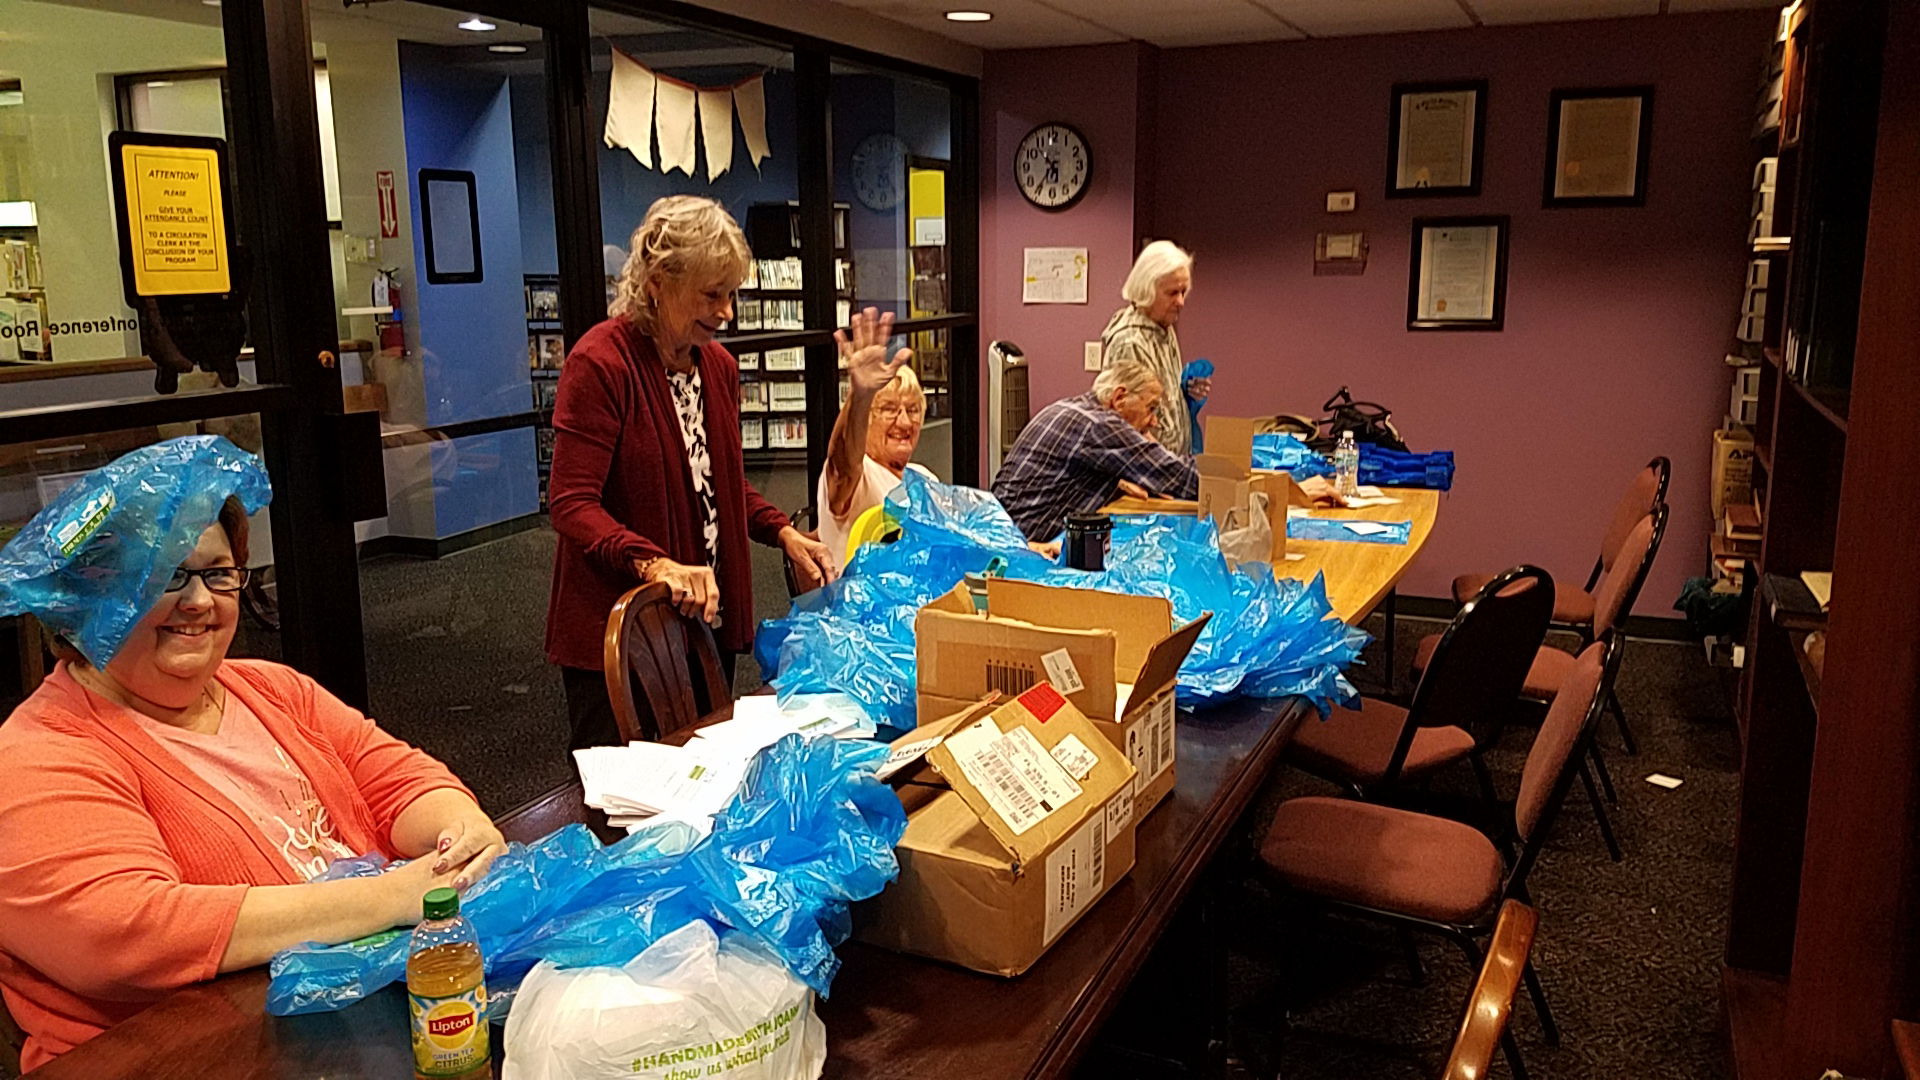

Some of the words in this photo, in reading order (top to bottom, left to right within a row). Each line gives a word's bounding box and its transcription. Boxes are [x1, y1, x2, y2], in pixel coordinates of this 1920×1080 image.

[1026, 148, 1038, 160] 10
[1072, 146, 1080, 158] 2
[1076, 159, 1084, 172] 3
[148, 169, 199, 180] ATTENTION!
[158, 206, 174, 214] GIVE
[177, 206, 193, 214] YOUR
[144, 215, 186, 223] ATTENDANCE
[187, 215, 208, 223] COUNT
[149, 231, 157, 239] TO
[166, 231, 208, 239] CIRCULATION
[145, 248, 186, 256] CONCLUSION
[188, 248, 196, 256] OF
[432, 1016, 471, 1034] Lipton
[432, 1052, 459, 1060] GREEN
[435, 1054, 474, 1069] CITRUS
[707, 1061, 722, 1076] us
